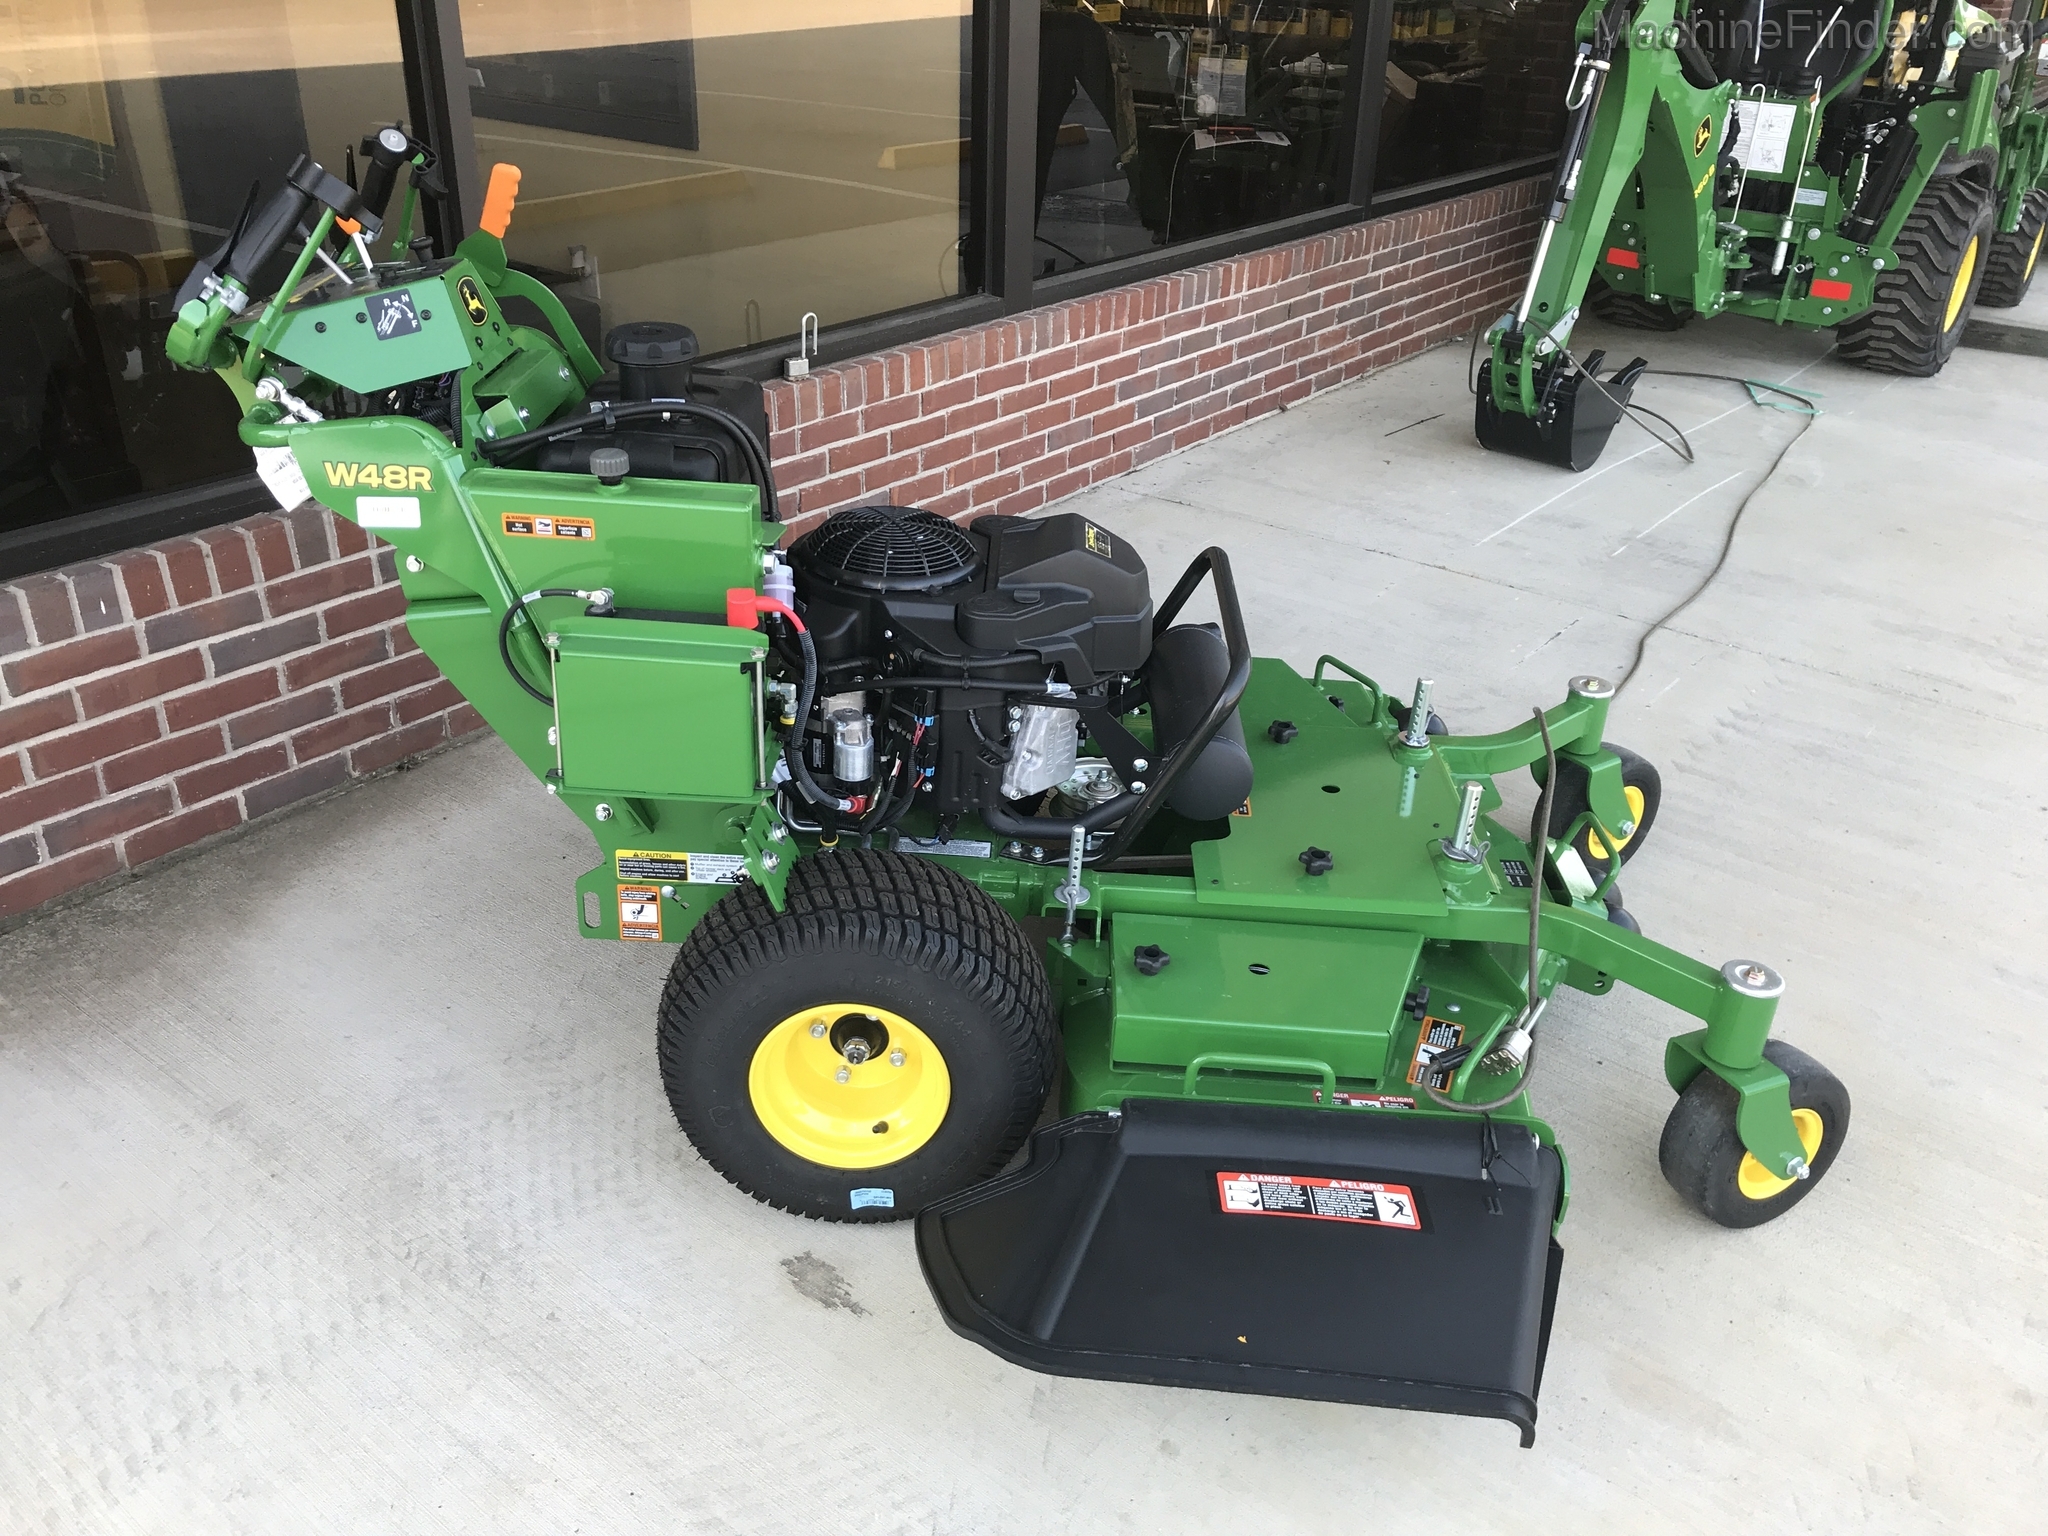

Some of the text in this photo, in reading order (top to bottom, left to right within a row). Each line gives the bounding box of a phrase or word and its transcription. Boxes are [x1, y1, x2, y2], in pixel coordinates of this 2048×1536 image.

[383, 294, 410, 307] R N
[411, 319, 418, 328] F
[323, 461, 436, 493] W48R
[1251, 1174, 1292, 1184] DANGER
[1341, 1181, 1385, 1192] PELIGRO
